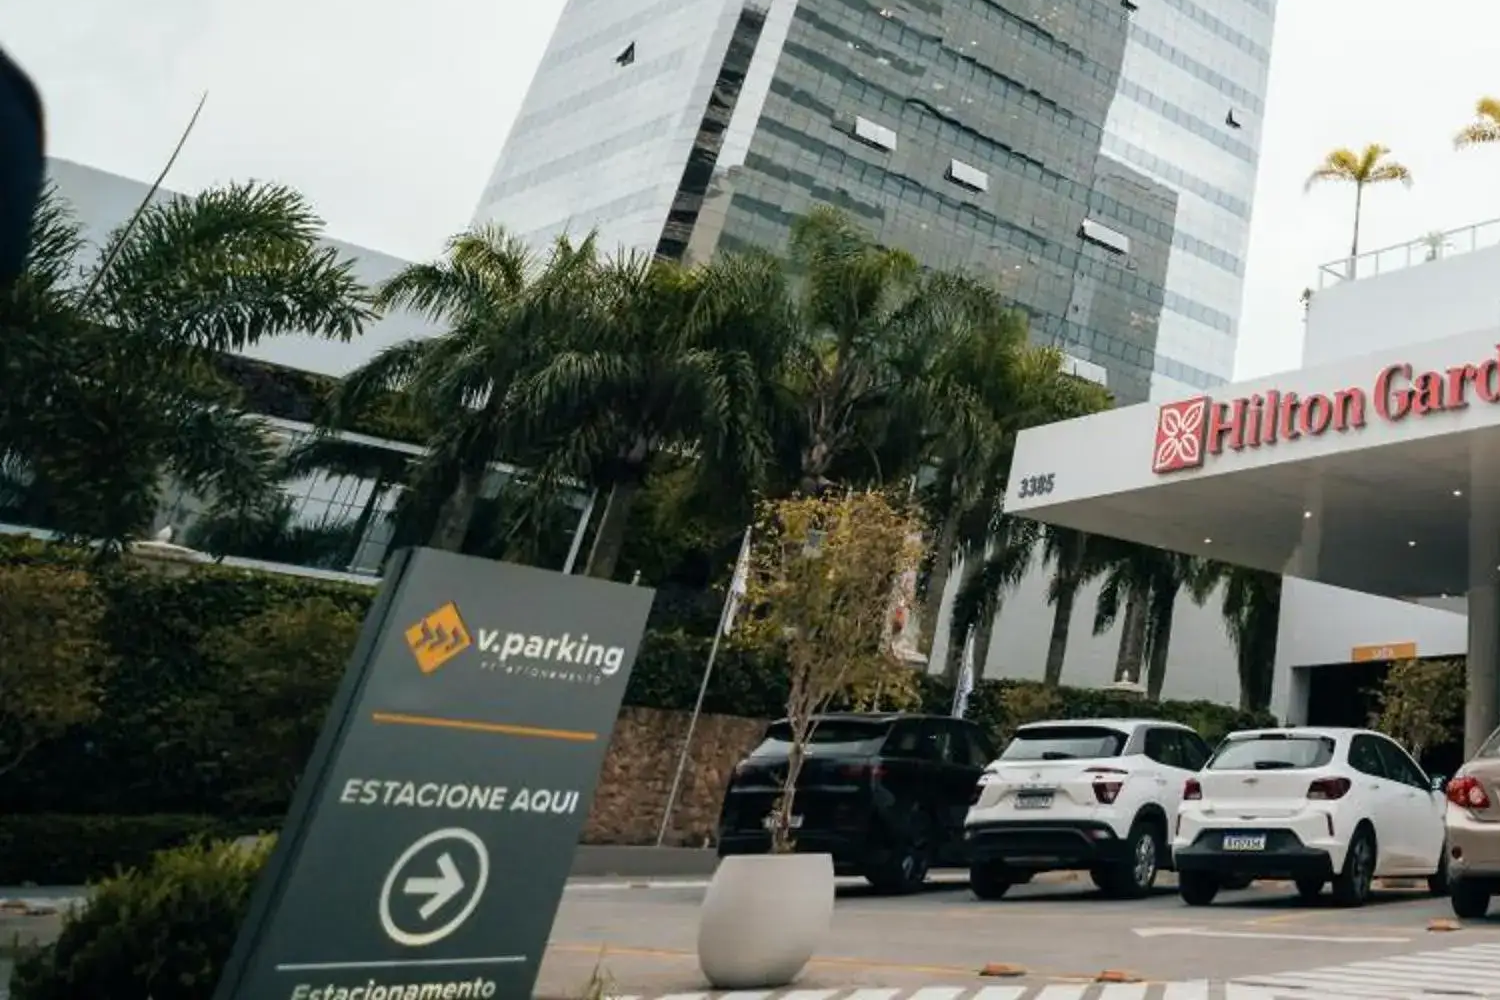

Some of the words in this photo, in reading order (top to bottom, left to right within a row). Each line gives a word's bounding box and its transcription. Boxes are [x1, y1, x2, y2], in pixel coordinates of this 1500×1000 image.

[1207, 387, 1366, 454] Hilton
[1018, 472, 1056, 498] 3385
[477, 627, 625, 676] v.parking
[339, 779, 508, 809] ESTACIONE
[511, 788, 580, 814] AQUI
[290, 977, 496, 1000] Estacionamento
